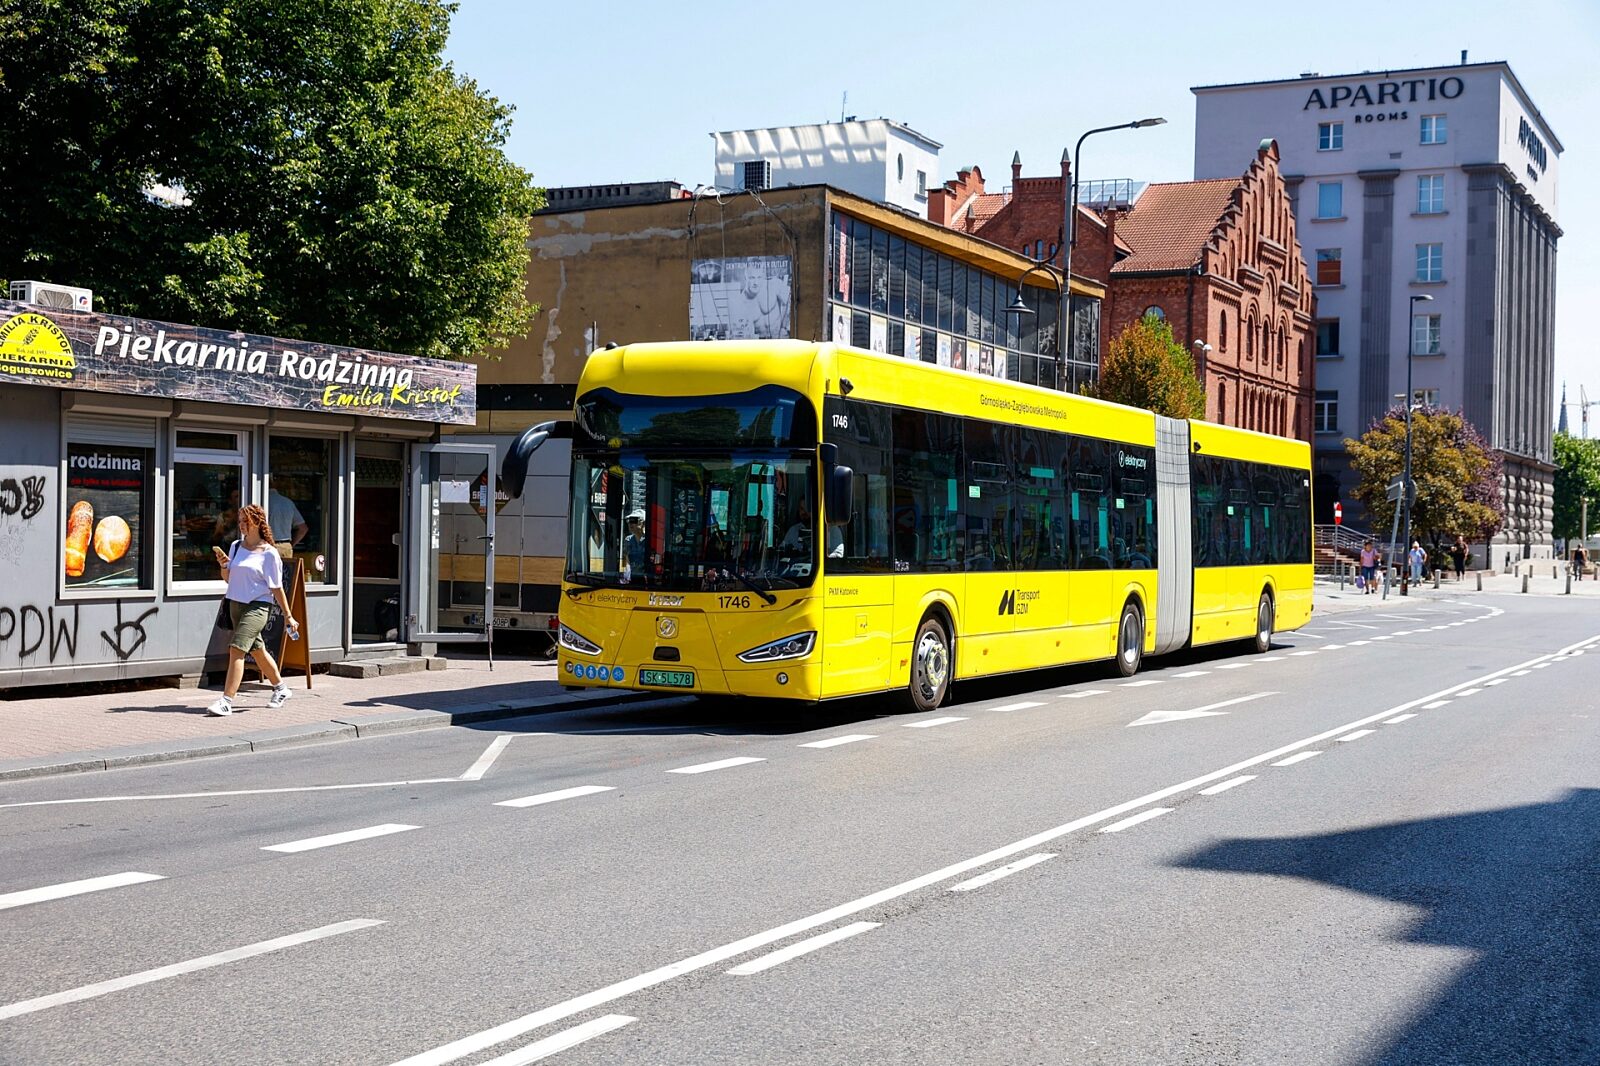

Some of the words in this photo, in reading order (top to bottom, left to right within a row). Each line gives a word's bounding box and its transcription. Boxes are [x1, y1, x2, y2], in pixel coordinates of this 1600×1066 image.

[1303, 77, 1465, 111] APARTIO
[1355, 111, 1409, 124] ROOMS
[0, 353, 73, 367] IEKARNIA
[94, 326, 268, 374] Piekarnia
[279, 350, 413, 389] Rodzinna
[0, 364, 73, 379] oguszowice
[322, 386, 385, 408] Emilia
[389, 383, 463, 407] Kristof
[832, 414, 848, 429] 1746
[70, 452, 141, 471] rodzinna
[597, 593, 638, 605] elektryczny
[718, 595, 750, 609] 1746
[1016, 589, 1040, 602] Transport
[1016, 603, 1029, 615] GZM
[645, 671, 658, 683] SK
[661, 672, 691, 685] 5L578
